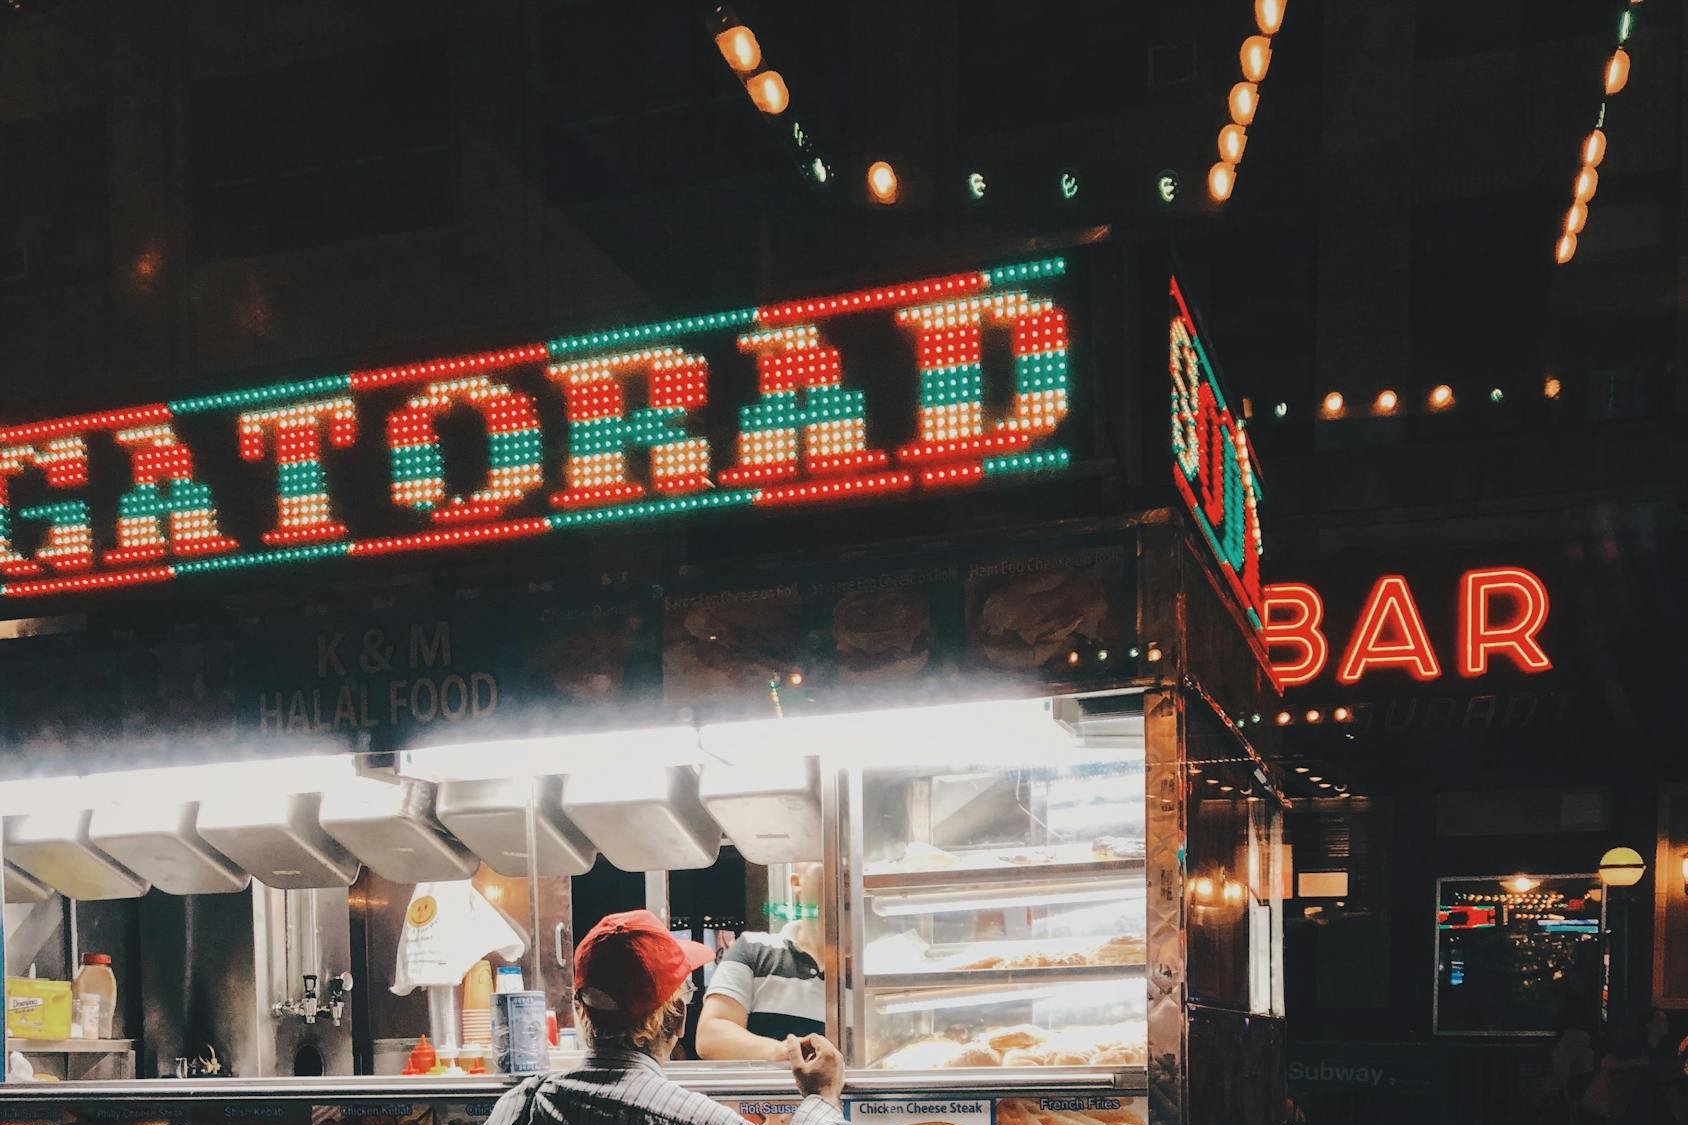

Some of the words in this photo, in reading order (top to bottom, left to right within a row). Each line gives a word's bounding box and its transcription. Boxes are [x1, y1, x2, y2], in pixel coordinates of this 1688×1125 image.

[0, 289, 1070, 572] GATORAD
[1263, 566, 1553, 686] BAR
[317, 630, 345, 677] K
[358, 627, 394, 674] &
[408, 620, 452, 669] M
[258, 682, 380, 735] HALAL
[388, 672, 500, 727] FOOD
[1288, 1061, 1384, 1087] Subway
[740, 1102, 760, 1114] Hot
[763, 1103, 799, 1115] Sausa
[859, 1102, 904, 1115] Chicken
[906, 1102, 948, 1115] Cheese
[950, 1102, 983, 1115] Steak
[1039, 1098, 1085, 1111] French
[1086, 1097, 1120, 1110] Fries
